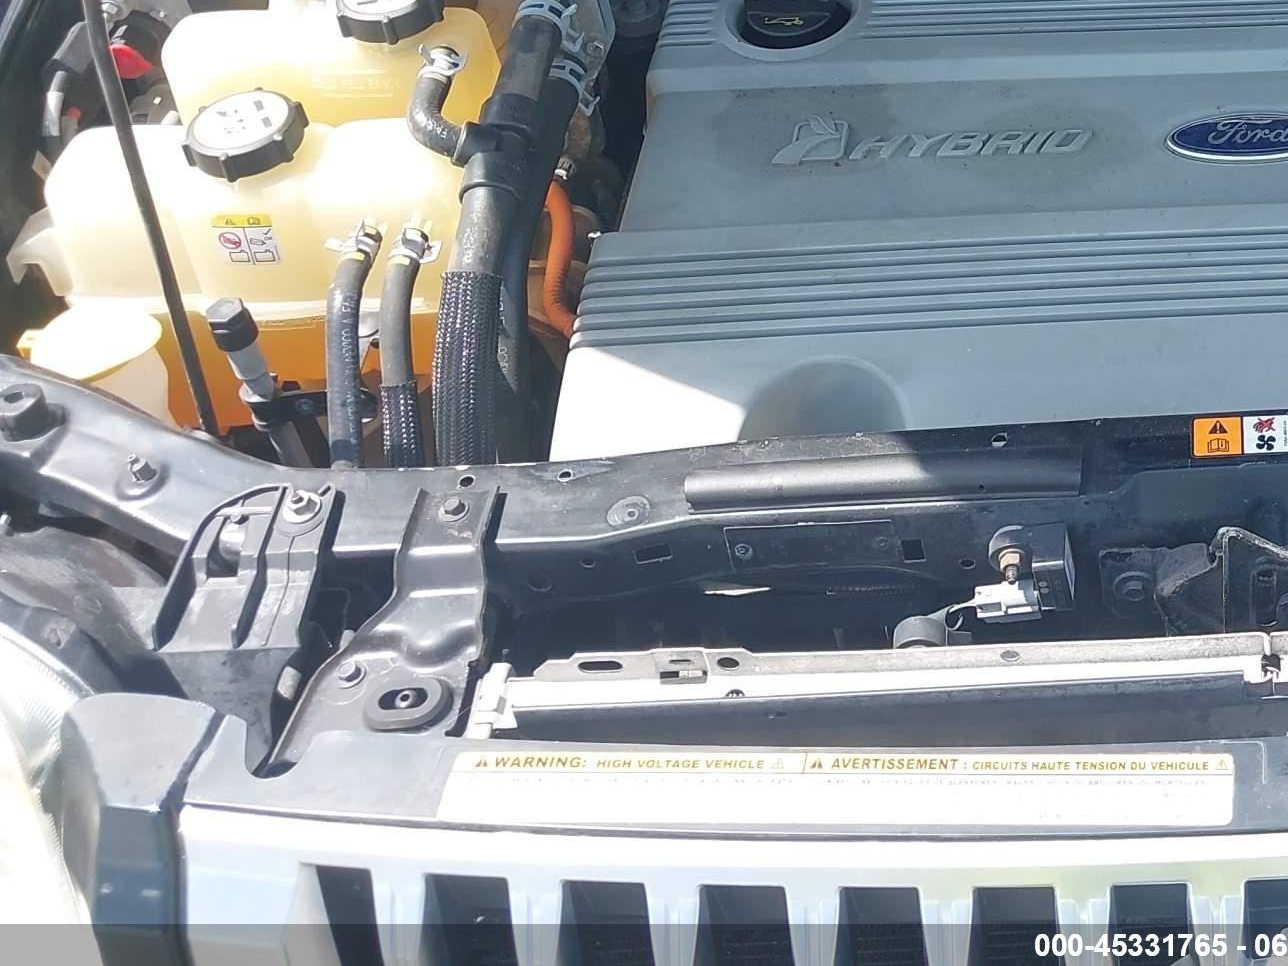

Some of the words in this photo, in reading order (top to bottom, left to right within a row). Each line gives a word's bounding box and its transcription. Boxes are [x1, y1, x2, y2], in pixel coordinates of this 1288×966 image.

[848, 129, 1097, 160] HYBRID
[495, 756, 587, 769] WARNING:
[597, 759, 632, 769] HIGH
[638, 759, 700, 769] VOLTAGE
[705, 759, 765, 769] VEHICLE
[831, 757, 959, 770] AVERTISSEMENT
[972, 760, 1028, 771] CIRCUITS
[1031, 761, 1070, 771] HAUTE
[1075, 761, 1126, 771] TENSION
[1130, 761, 1147, 771] DU
[1150, 761, 1209, 771] VEHICULE
